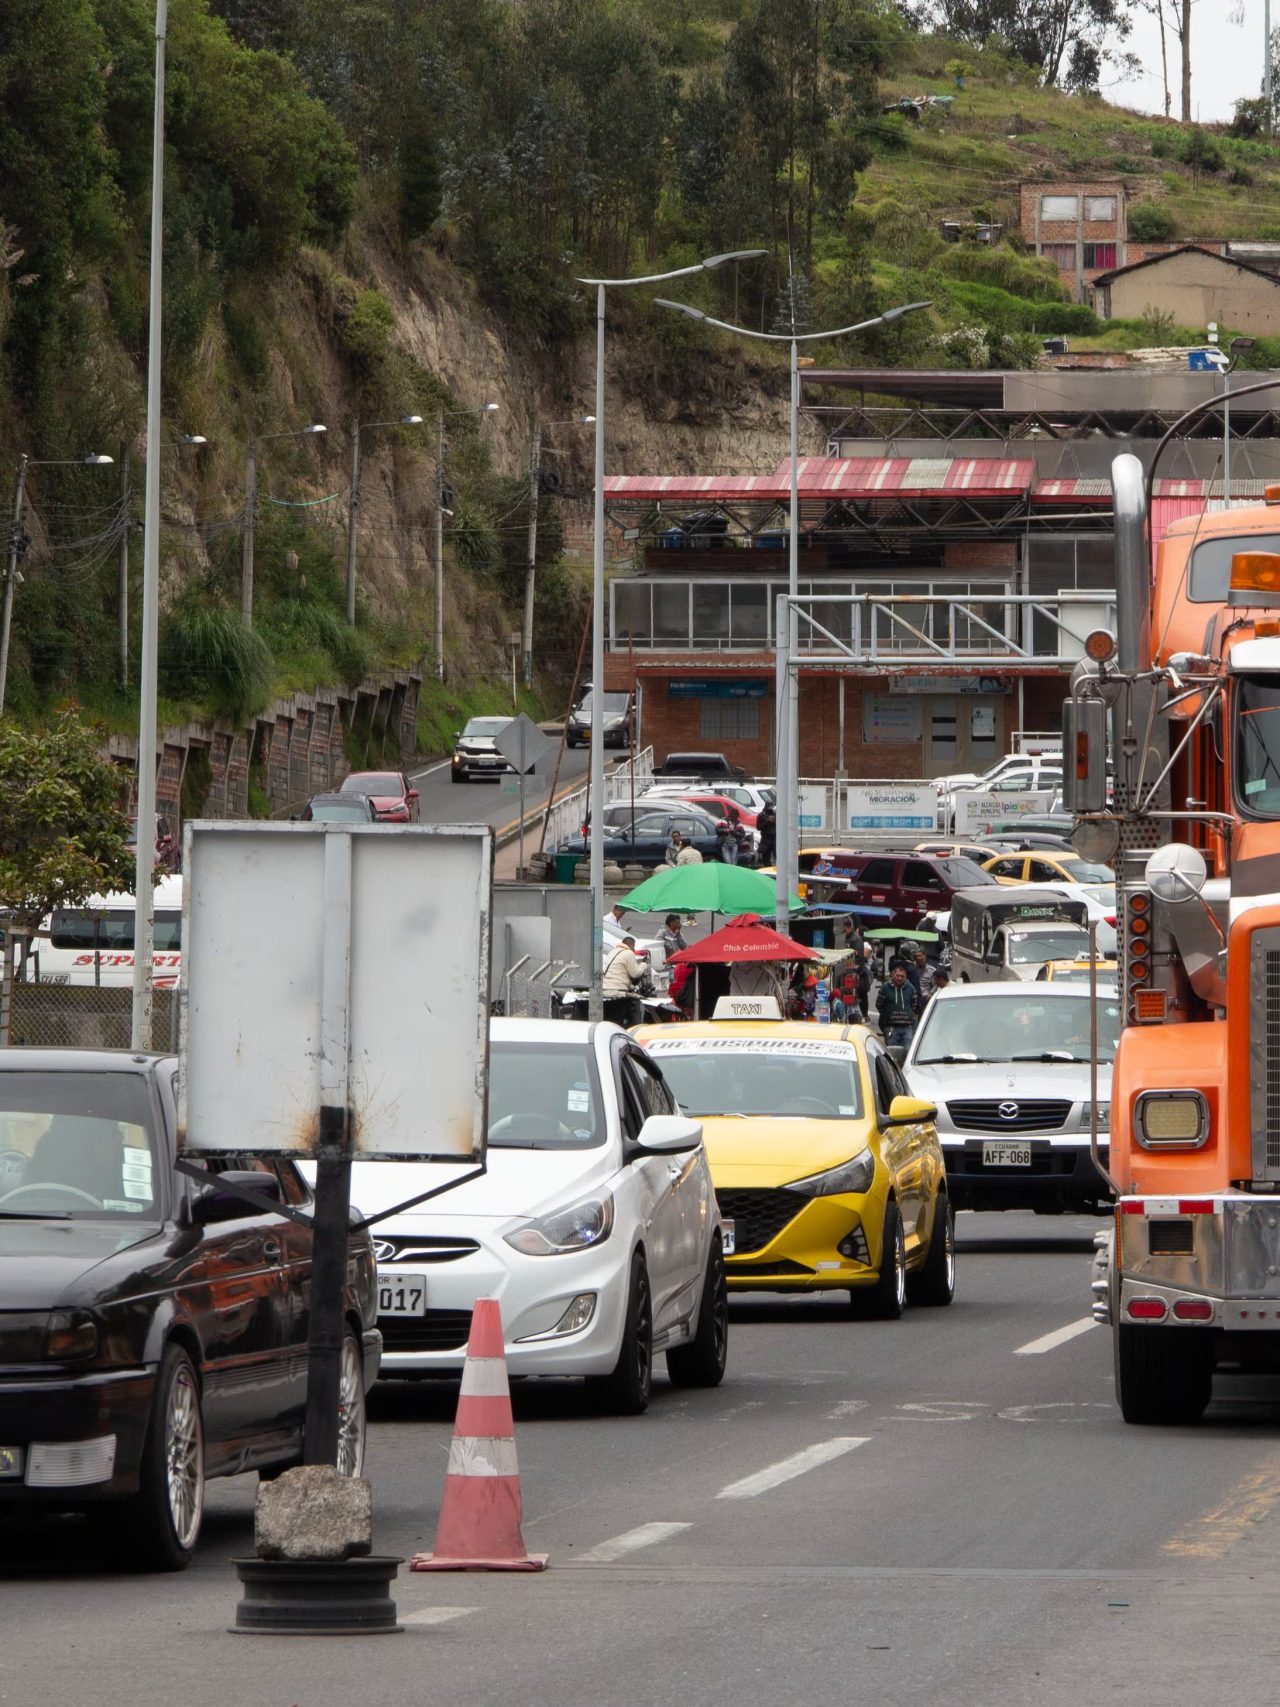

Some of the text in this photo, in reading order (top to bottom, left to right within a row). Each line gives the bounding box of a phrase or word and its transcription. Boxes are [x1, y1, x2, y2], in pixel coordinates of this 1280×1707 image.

[869, 794, 916, 803] MIGRACIÓN
[723, 944, 741, 952] Club
[731, 1003, 761, 1015] TAXI
[984, 1150, 1030, 1164] AFF-068
